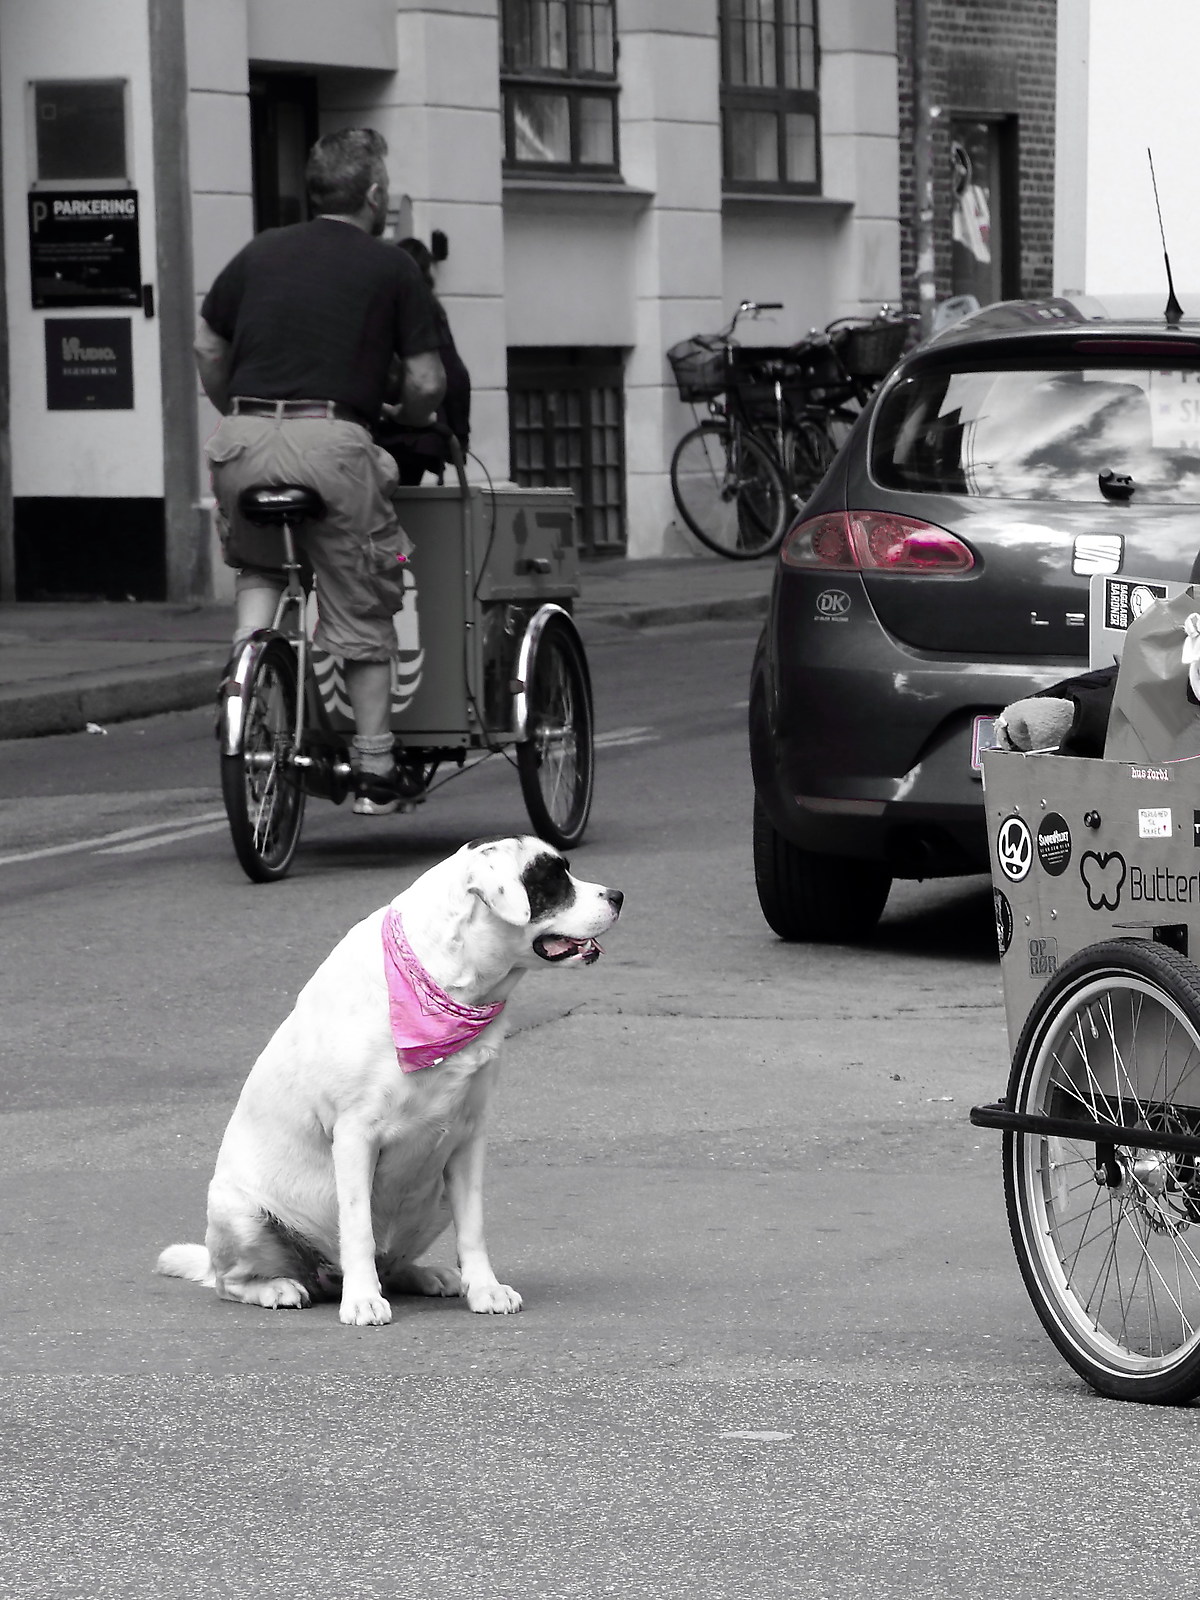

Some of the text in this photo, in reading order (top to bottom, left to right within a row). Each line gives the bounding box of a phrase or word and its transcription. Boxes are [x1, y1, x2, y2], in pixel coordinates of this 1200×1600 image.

[53, 198, 135, 215] PARKERING
[821, 594, 846, 611] DK
[1131, 766, 1147, 779] hus
[1029, 939, 1047, 957] OP
[1030, 955, 1058, 975] RØR
